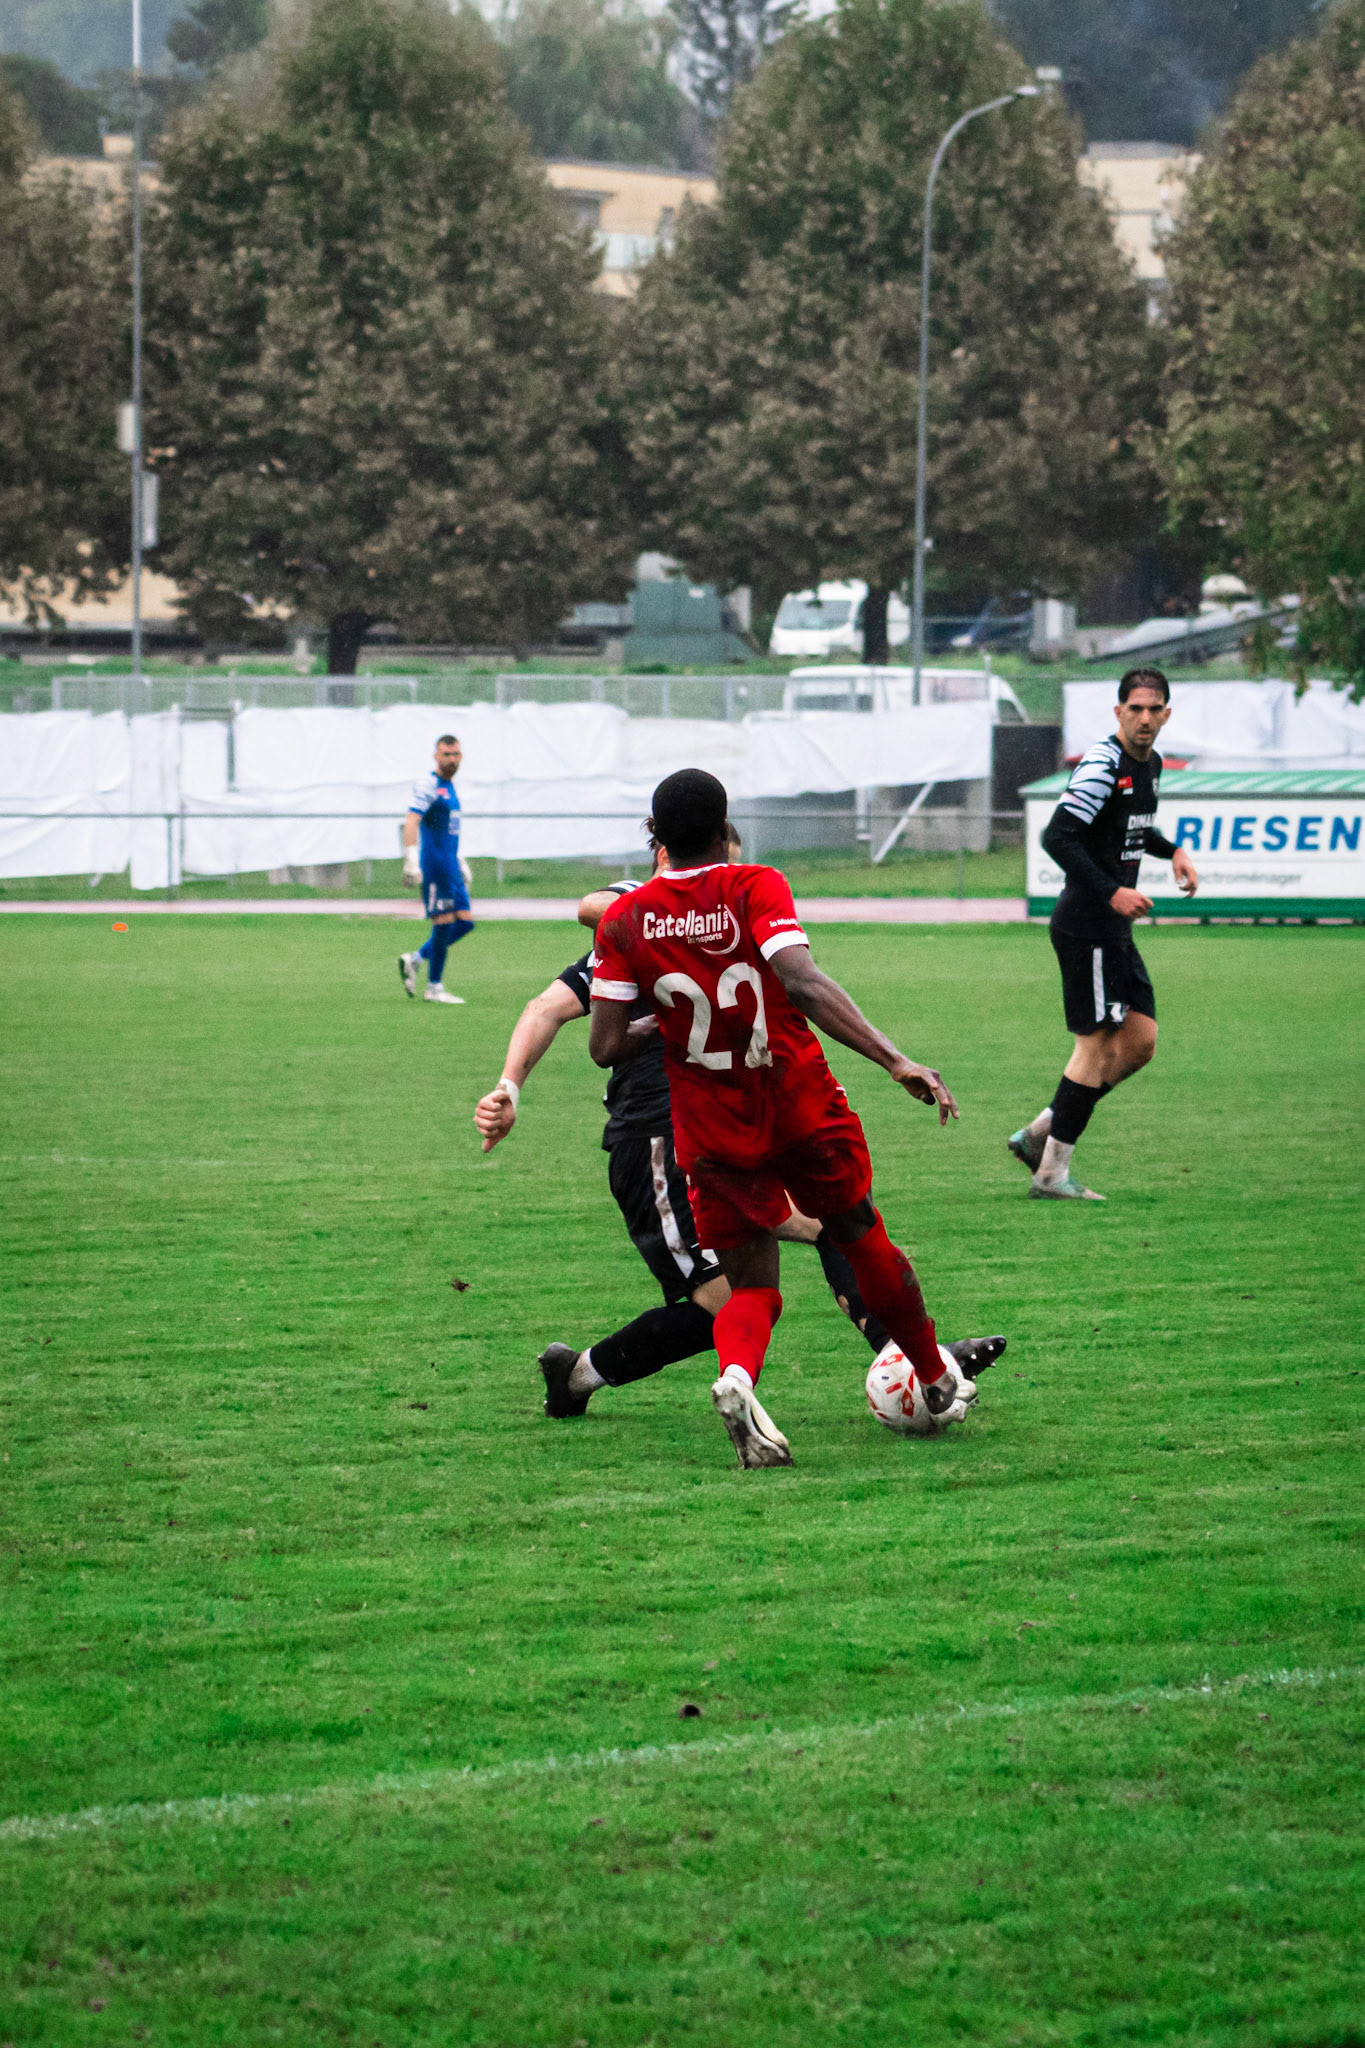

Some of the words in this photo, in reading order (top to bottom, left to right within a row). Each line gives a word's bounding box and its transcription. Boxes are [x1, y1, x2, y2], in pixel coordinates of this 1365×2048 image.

[1175, 816, 1363, 851] RIESEN
[643, 903, 722, 940] Catellani
[653, 962, 774, 1071] 22
